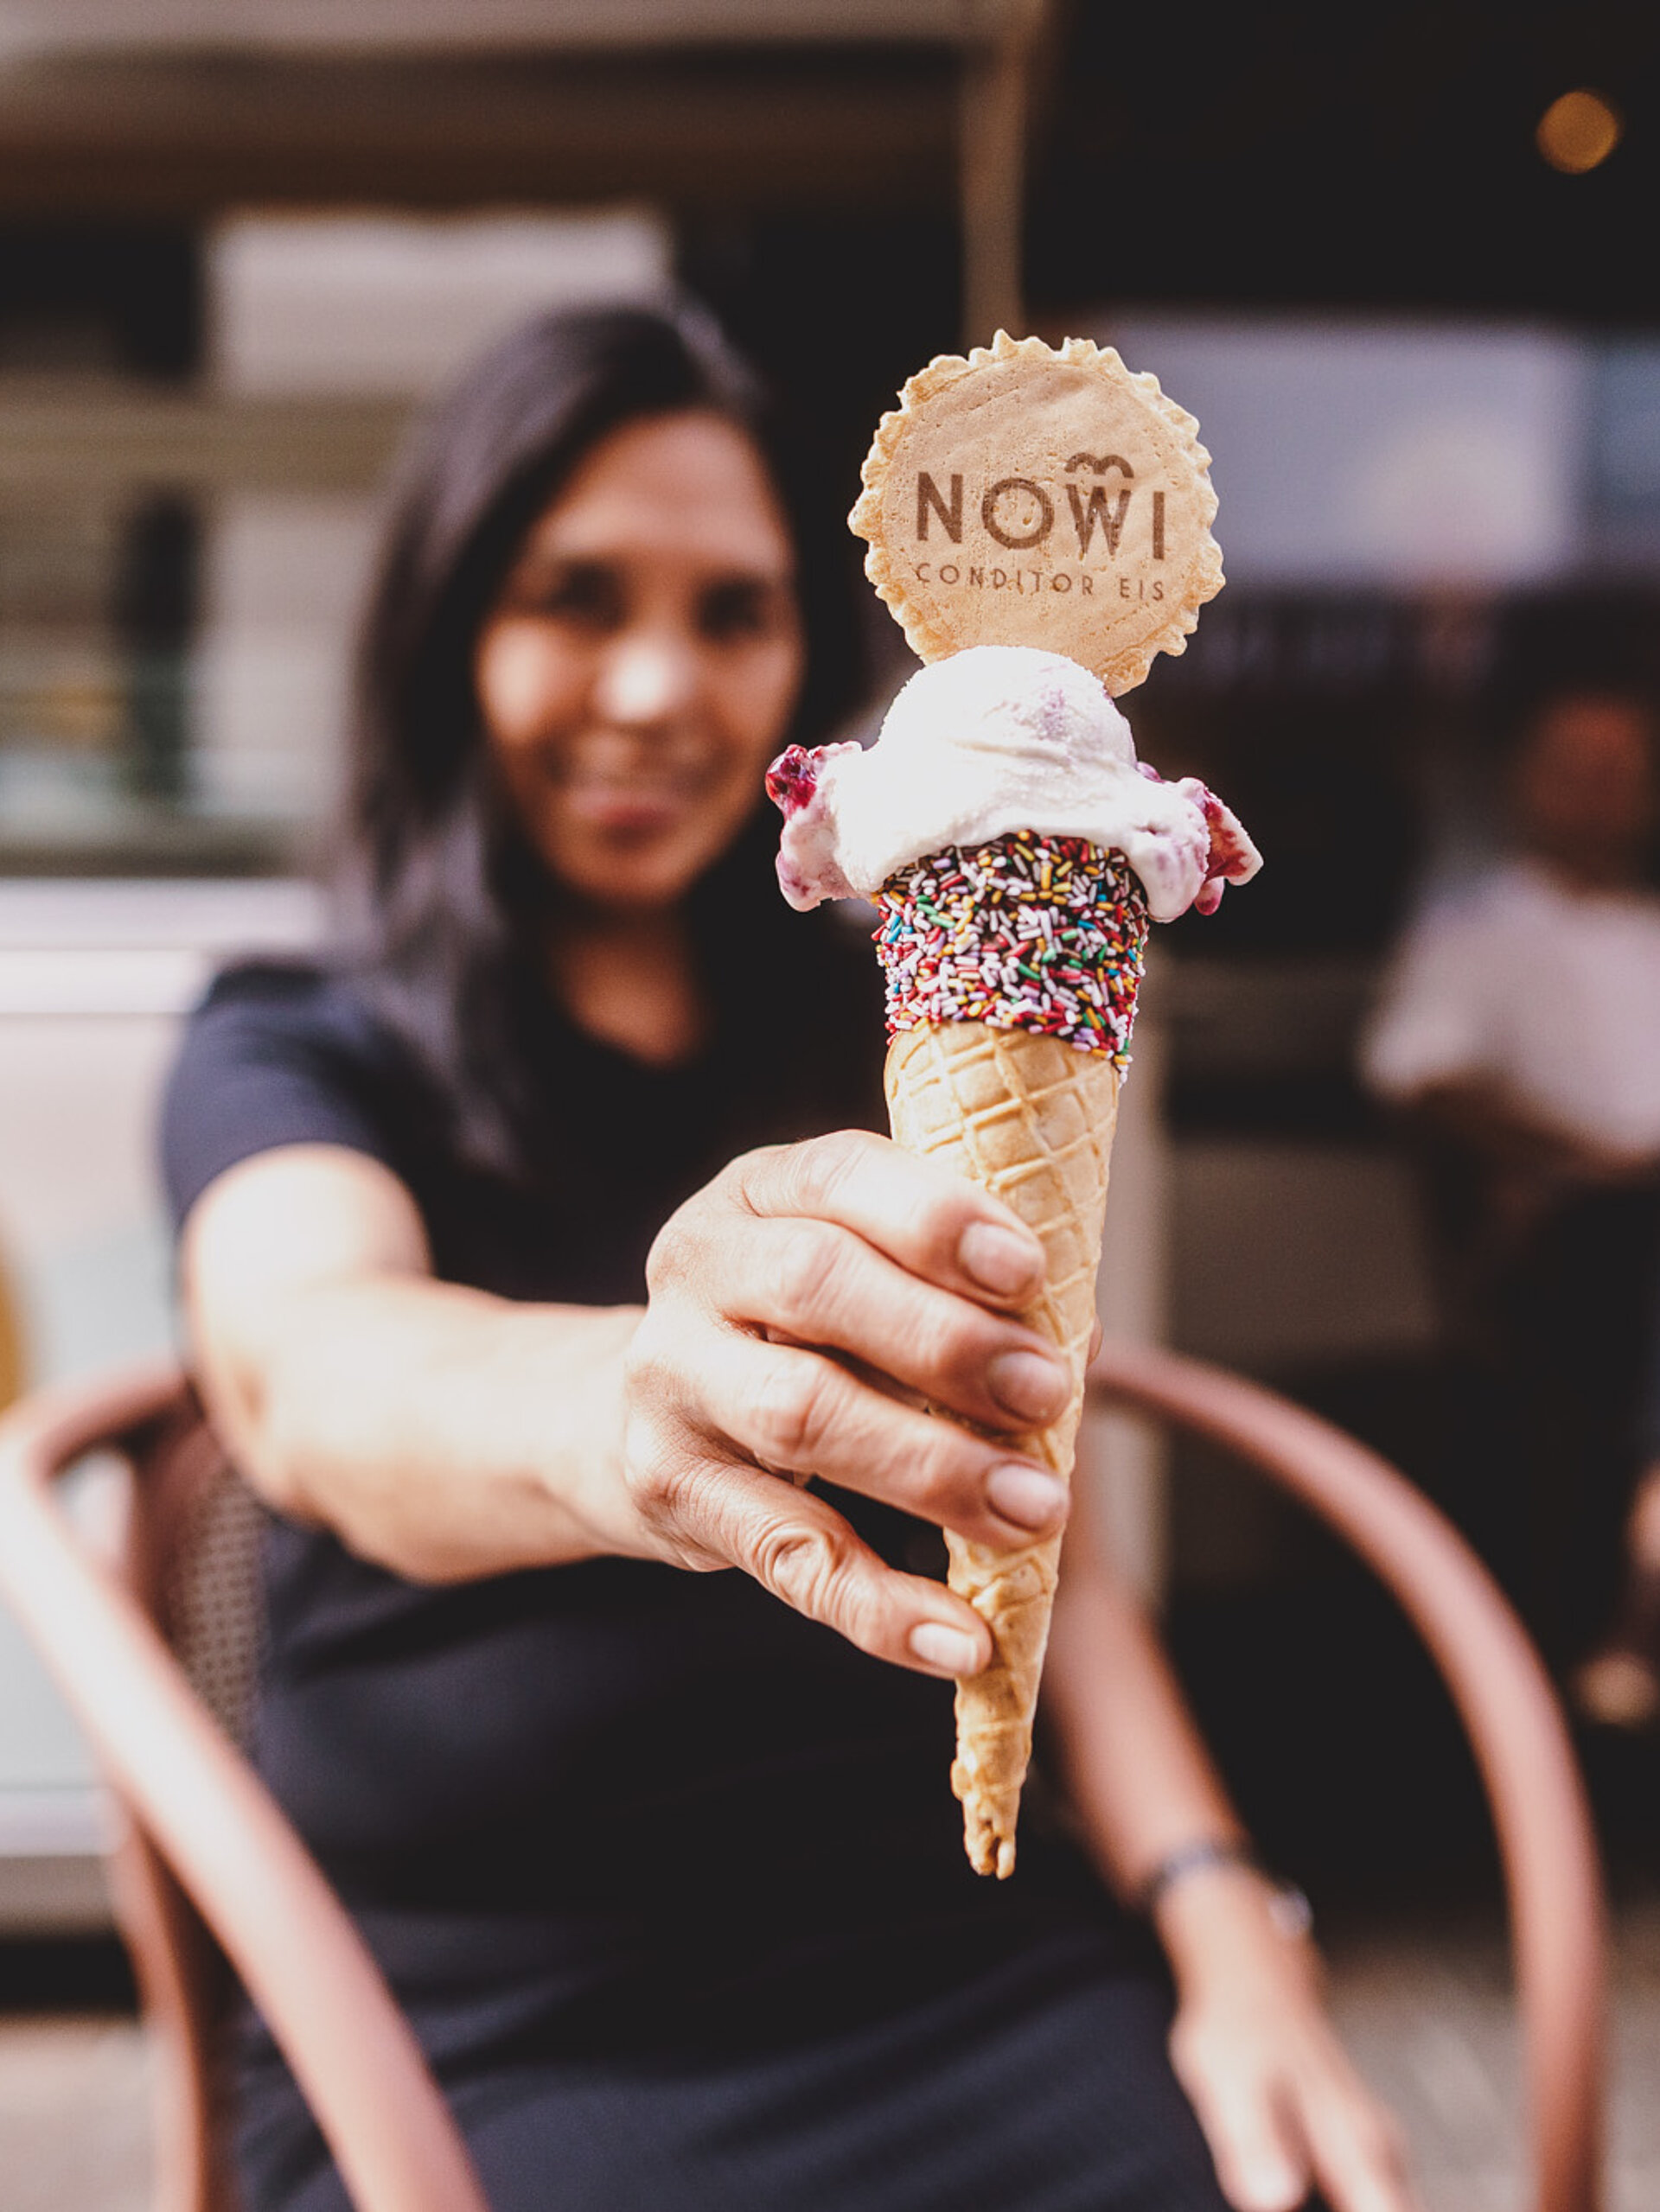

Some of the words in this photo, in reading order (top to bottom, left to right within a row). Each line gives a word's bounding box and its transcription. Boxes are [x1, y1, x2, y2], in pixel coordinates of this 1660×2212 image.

[916, 471, 1165, 561] NOWI
[916, 563, 1094, 596] CONDITOR
[1120, 577, 1165, 601] EIS
